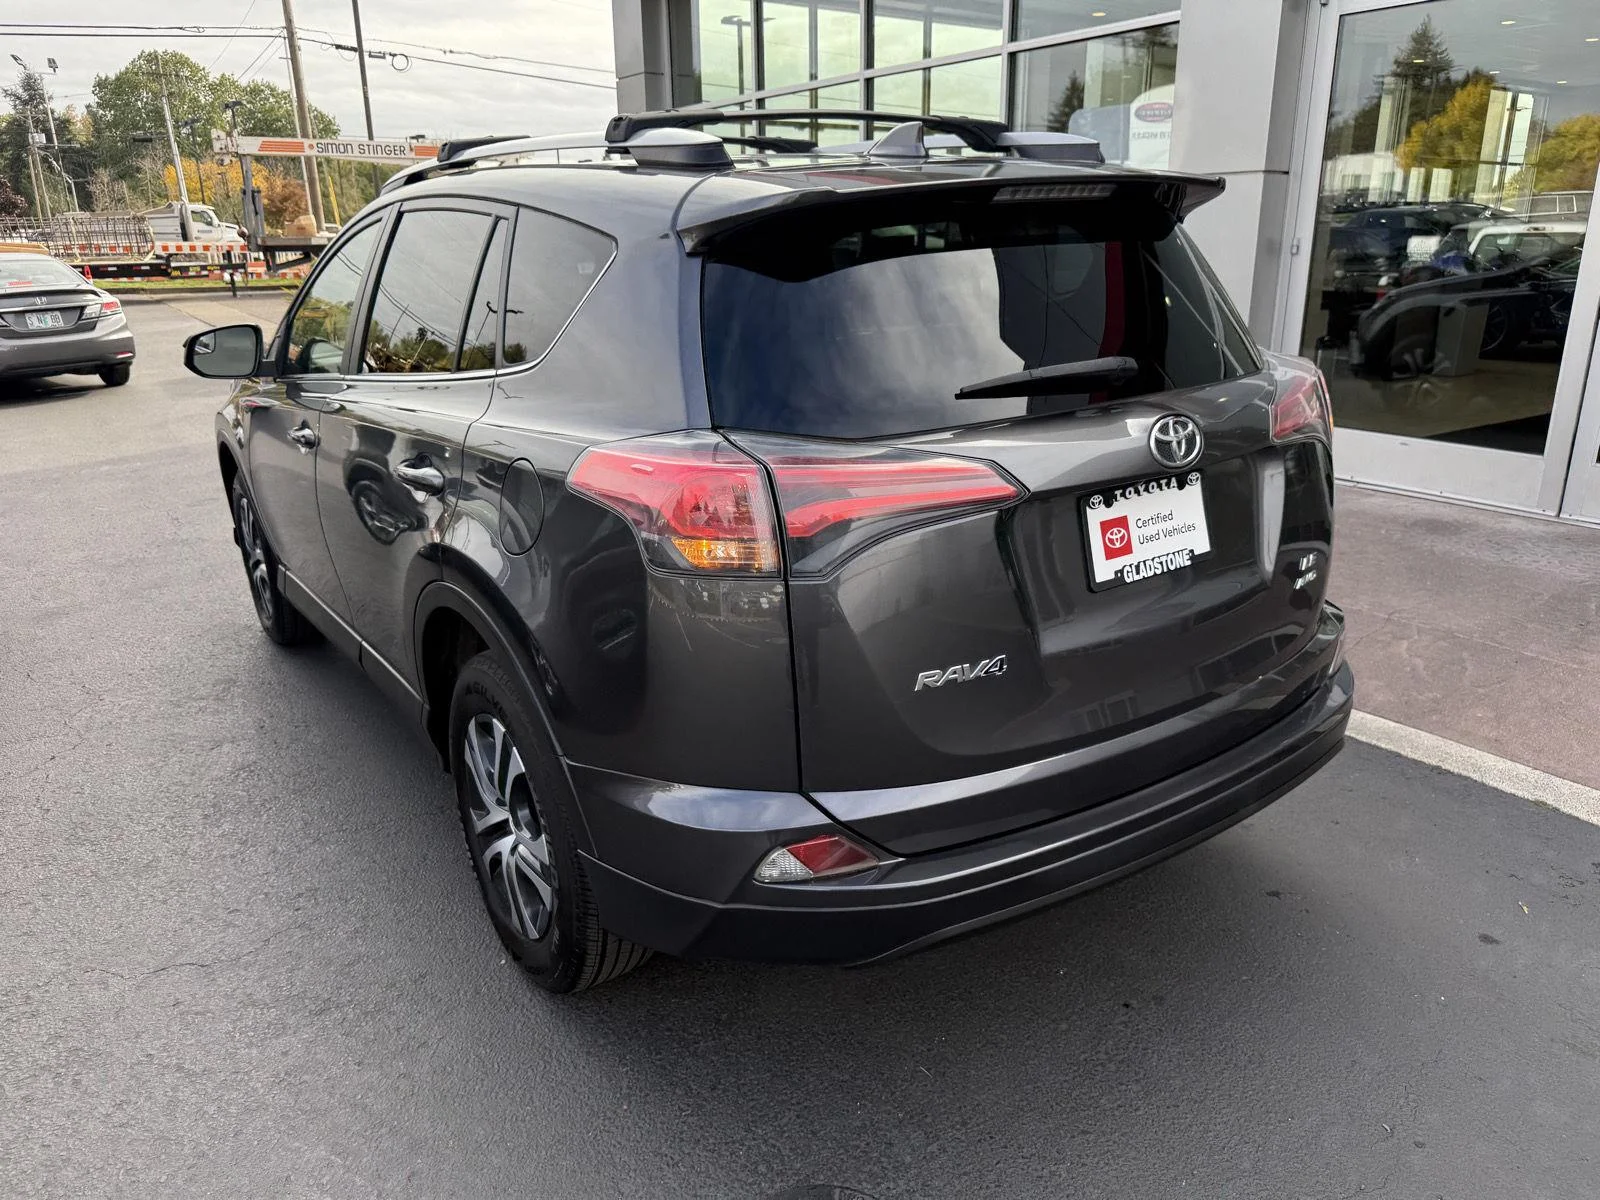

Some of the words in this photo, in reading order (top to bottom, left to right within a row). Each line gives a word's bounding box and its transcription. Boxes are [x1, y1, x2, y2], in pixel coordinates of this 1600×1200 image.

[316, 142, 354, 154] SIMON
[358, 143, 406, 156] STINGER
[1114, 477, 1178, 502] TOYOTA
[1135, 509, 1174, 529] Certified
[1137, 530, 1161, 545] Used
[1162, 522, 1196, 539] Vehicles
[1123, 548, 1192, 583] GLADSTONE
[914, 654, 1008, 692] RAV4
